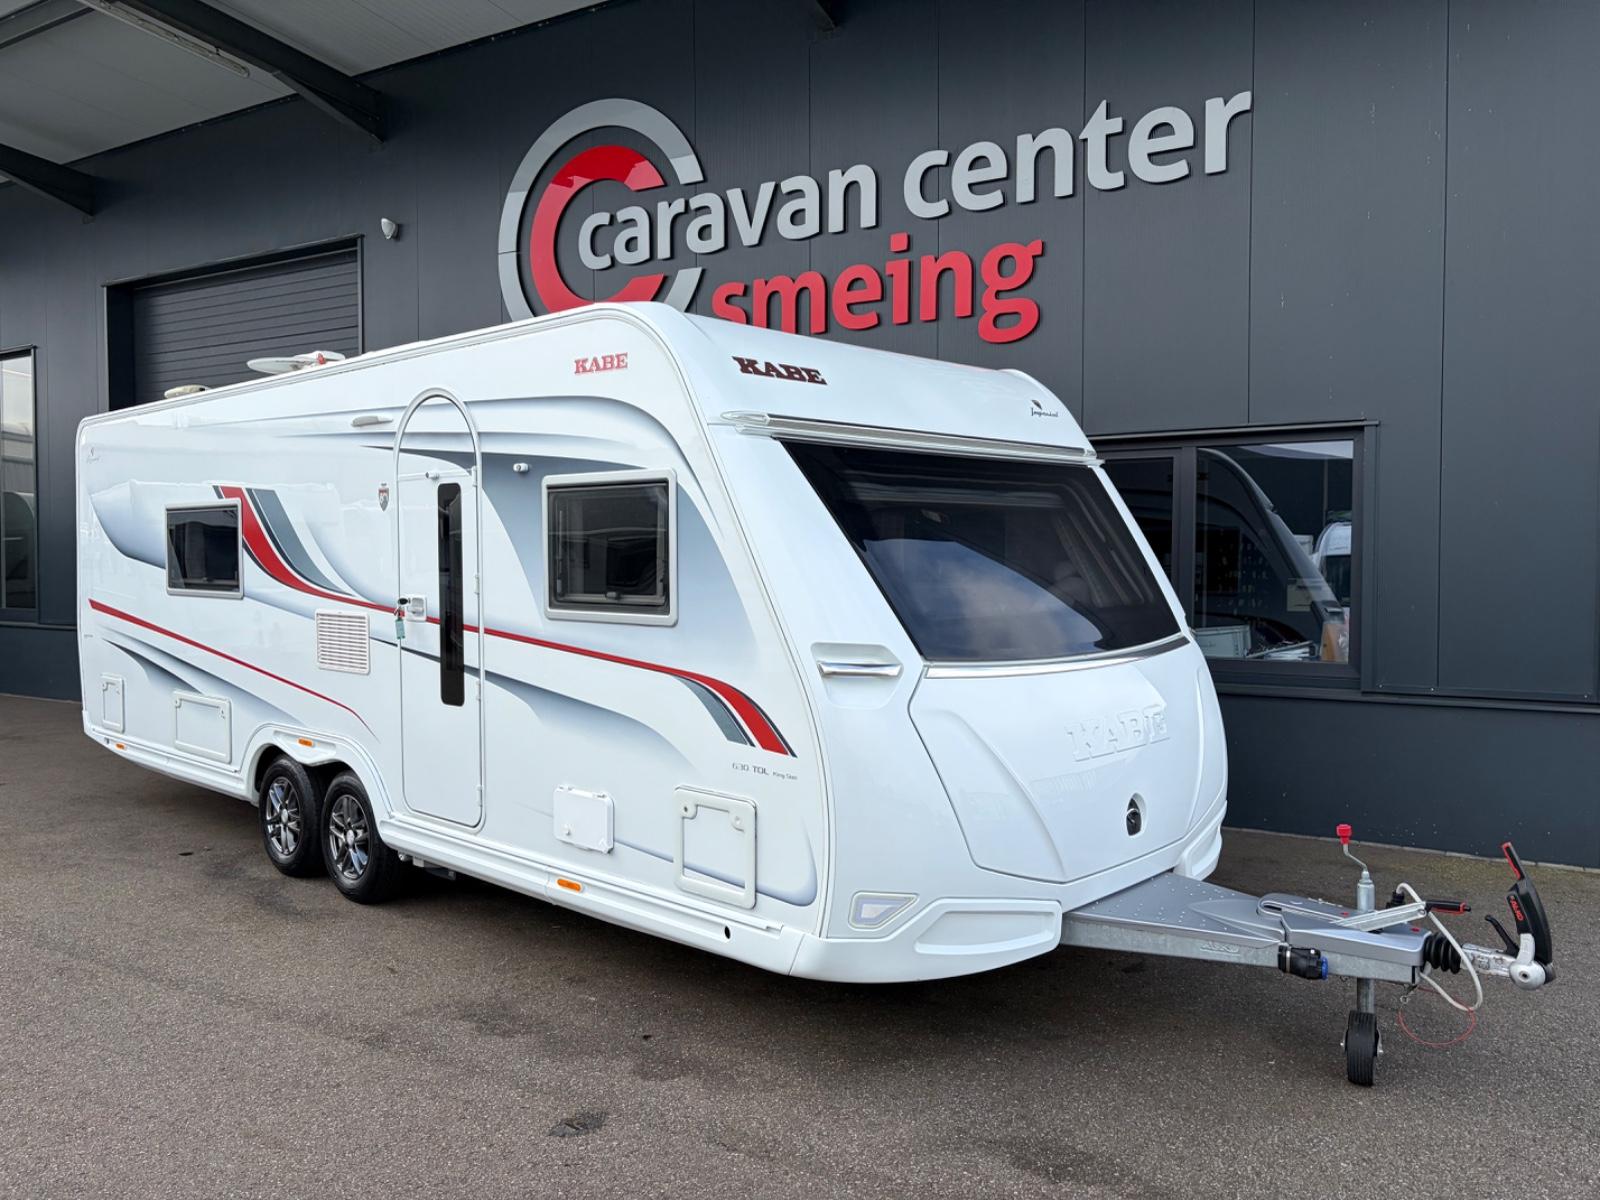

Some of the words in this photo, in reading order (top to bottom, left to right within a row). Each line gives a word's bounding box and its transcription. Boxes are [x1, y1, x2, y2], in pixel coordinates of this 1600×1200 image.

[577, 163, 878, 270] caravan
[903, 91, 1252, 218] center
[711, 231, 1044, 343] smeing
[574, 352, 628, 374] KABE
[731, 355, 828, 385] KABE
[1064, 704, 1170, 762] KABE
